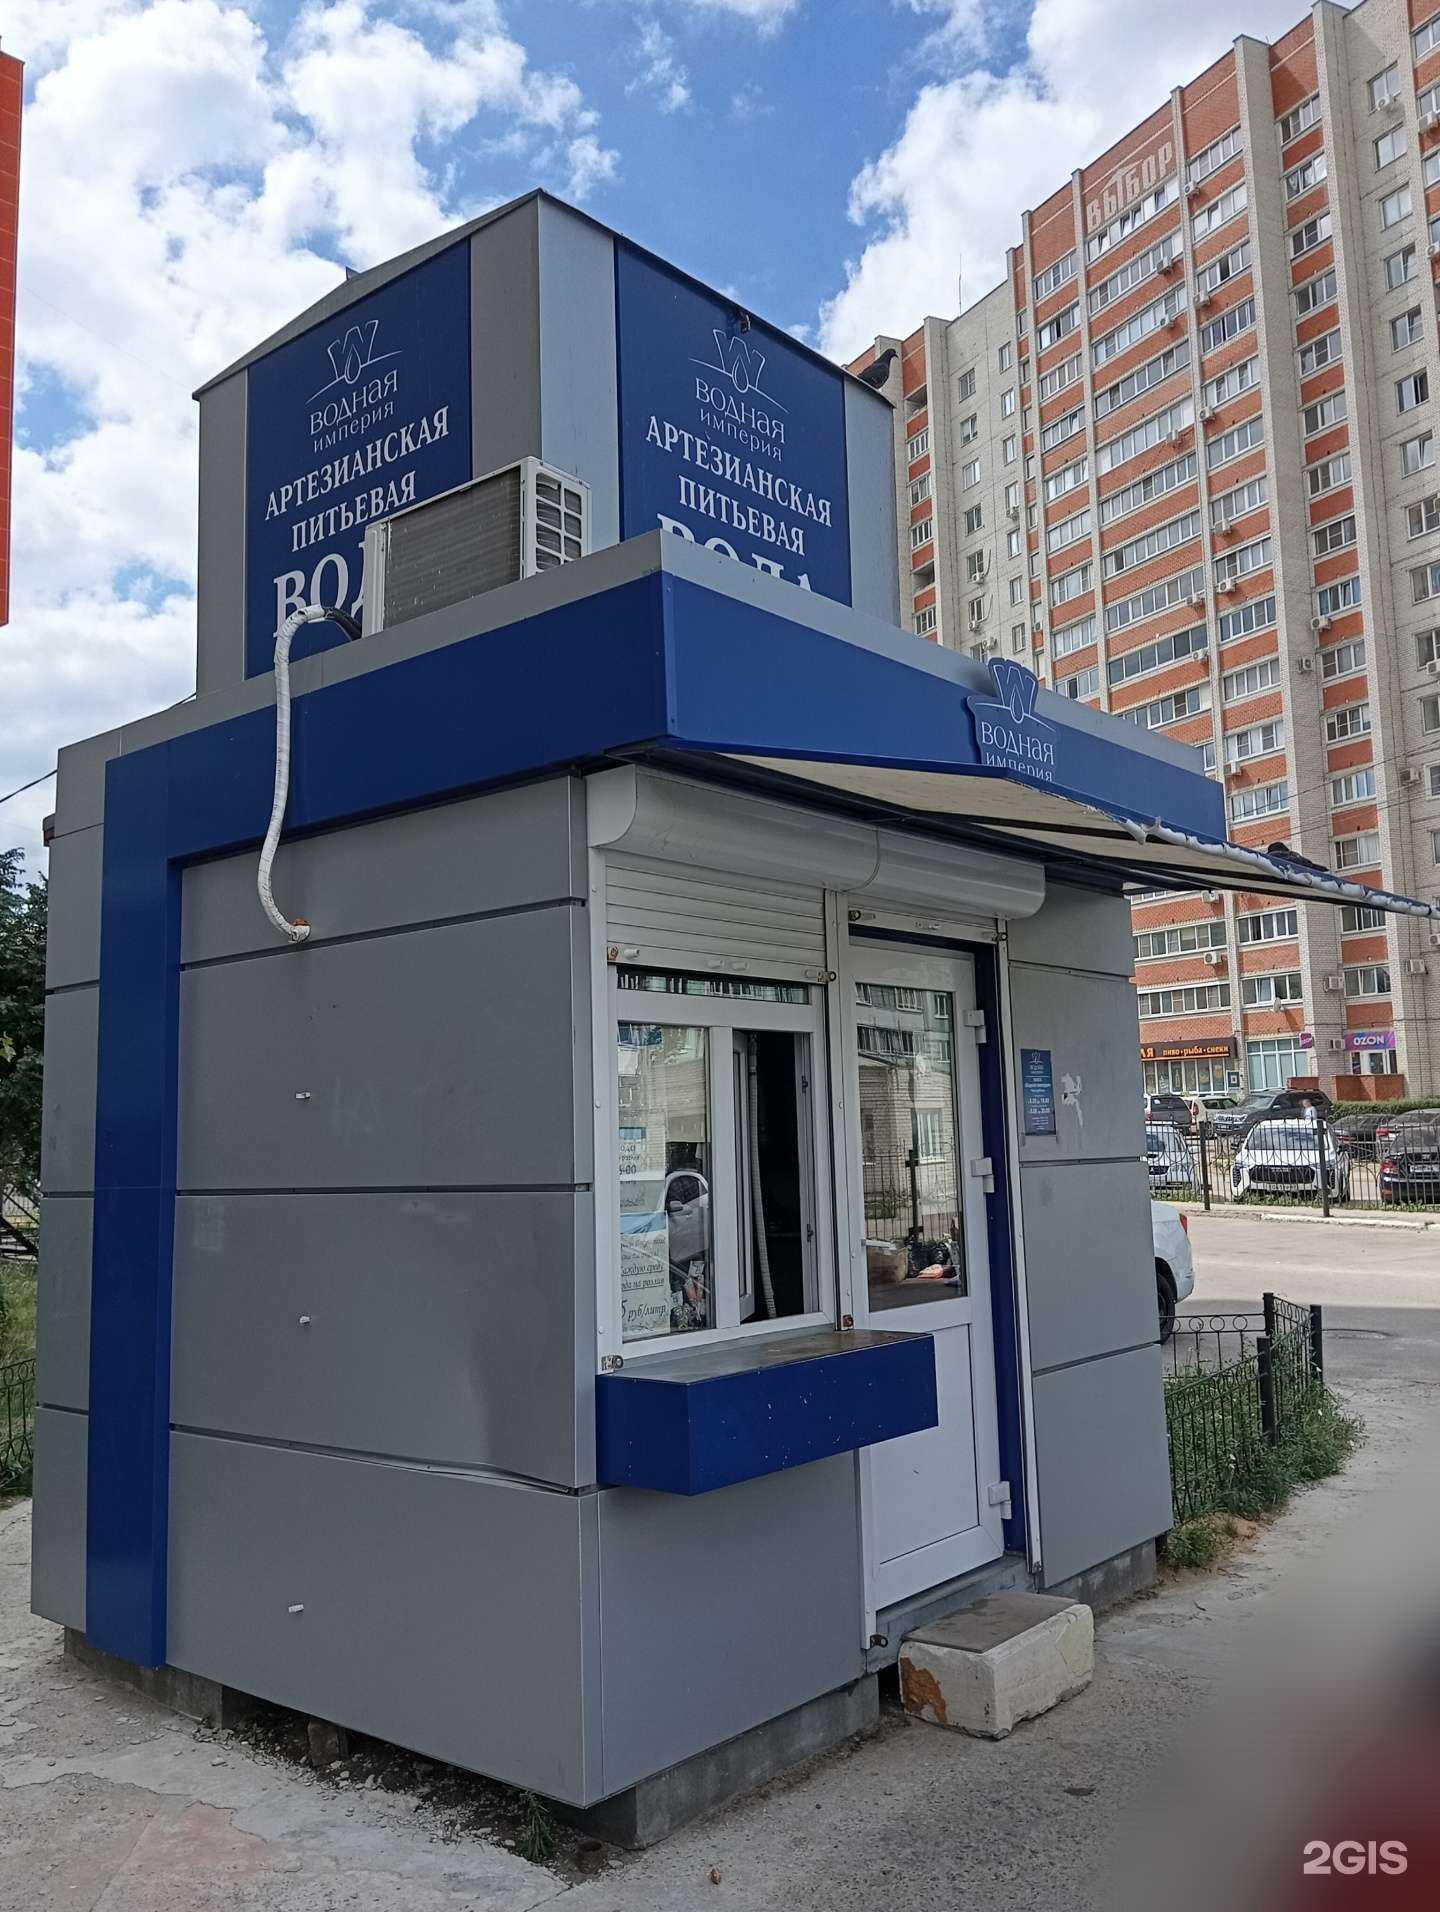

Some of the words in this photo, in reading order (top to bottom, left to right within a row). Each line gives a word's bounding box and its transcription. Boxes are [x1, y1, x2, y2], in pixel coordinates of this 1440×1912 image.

[314, 401, 394, 454] империя
[700, 408, 782, 462] империя
[265, 405, 450, 521] АРТЕЗИАНСКАЯ
[645, 415, 832, 527] АРТЕЗИАНСКАЯ
[291, 470, 417, 552] ПИТЬЕВАЯ
[678, 474, 806, 556] ПИТЬЕВАЯ
[1162, 1048, 1180, 1056] пиво
[1183, 1046, 1202, 1056] рыба
[1206, 1045, 1230, 1054] снеки
[1353, 1036, 1385, 1045] OZON
